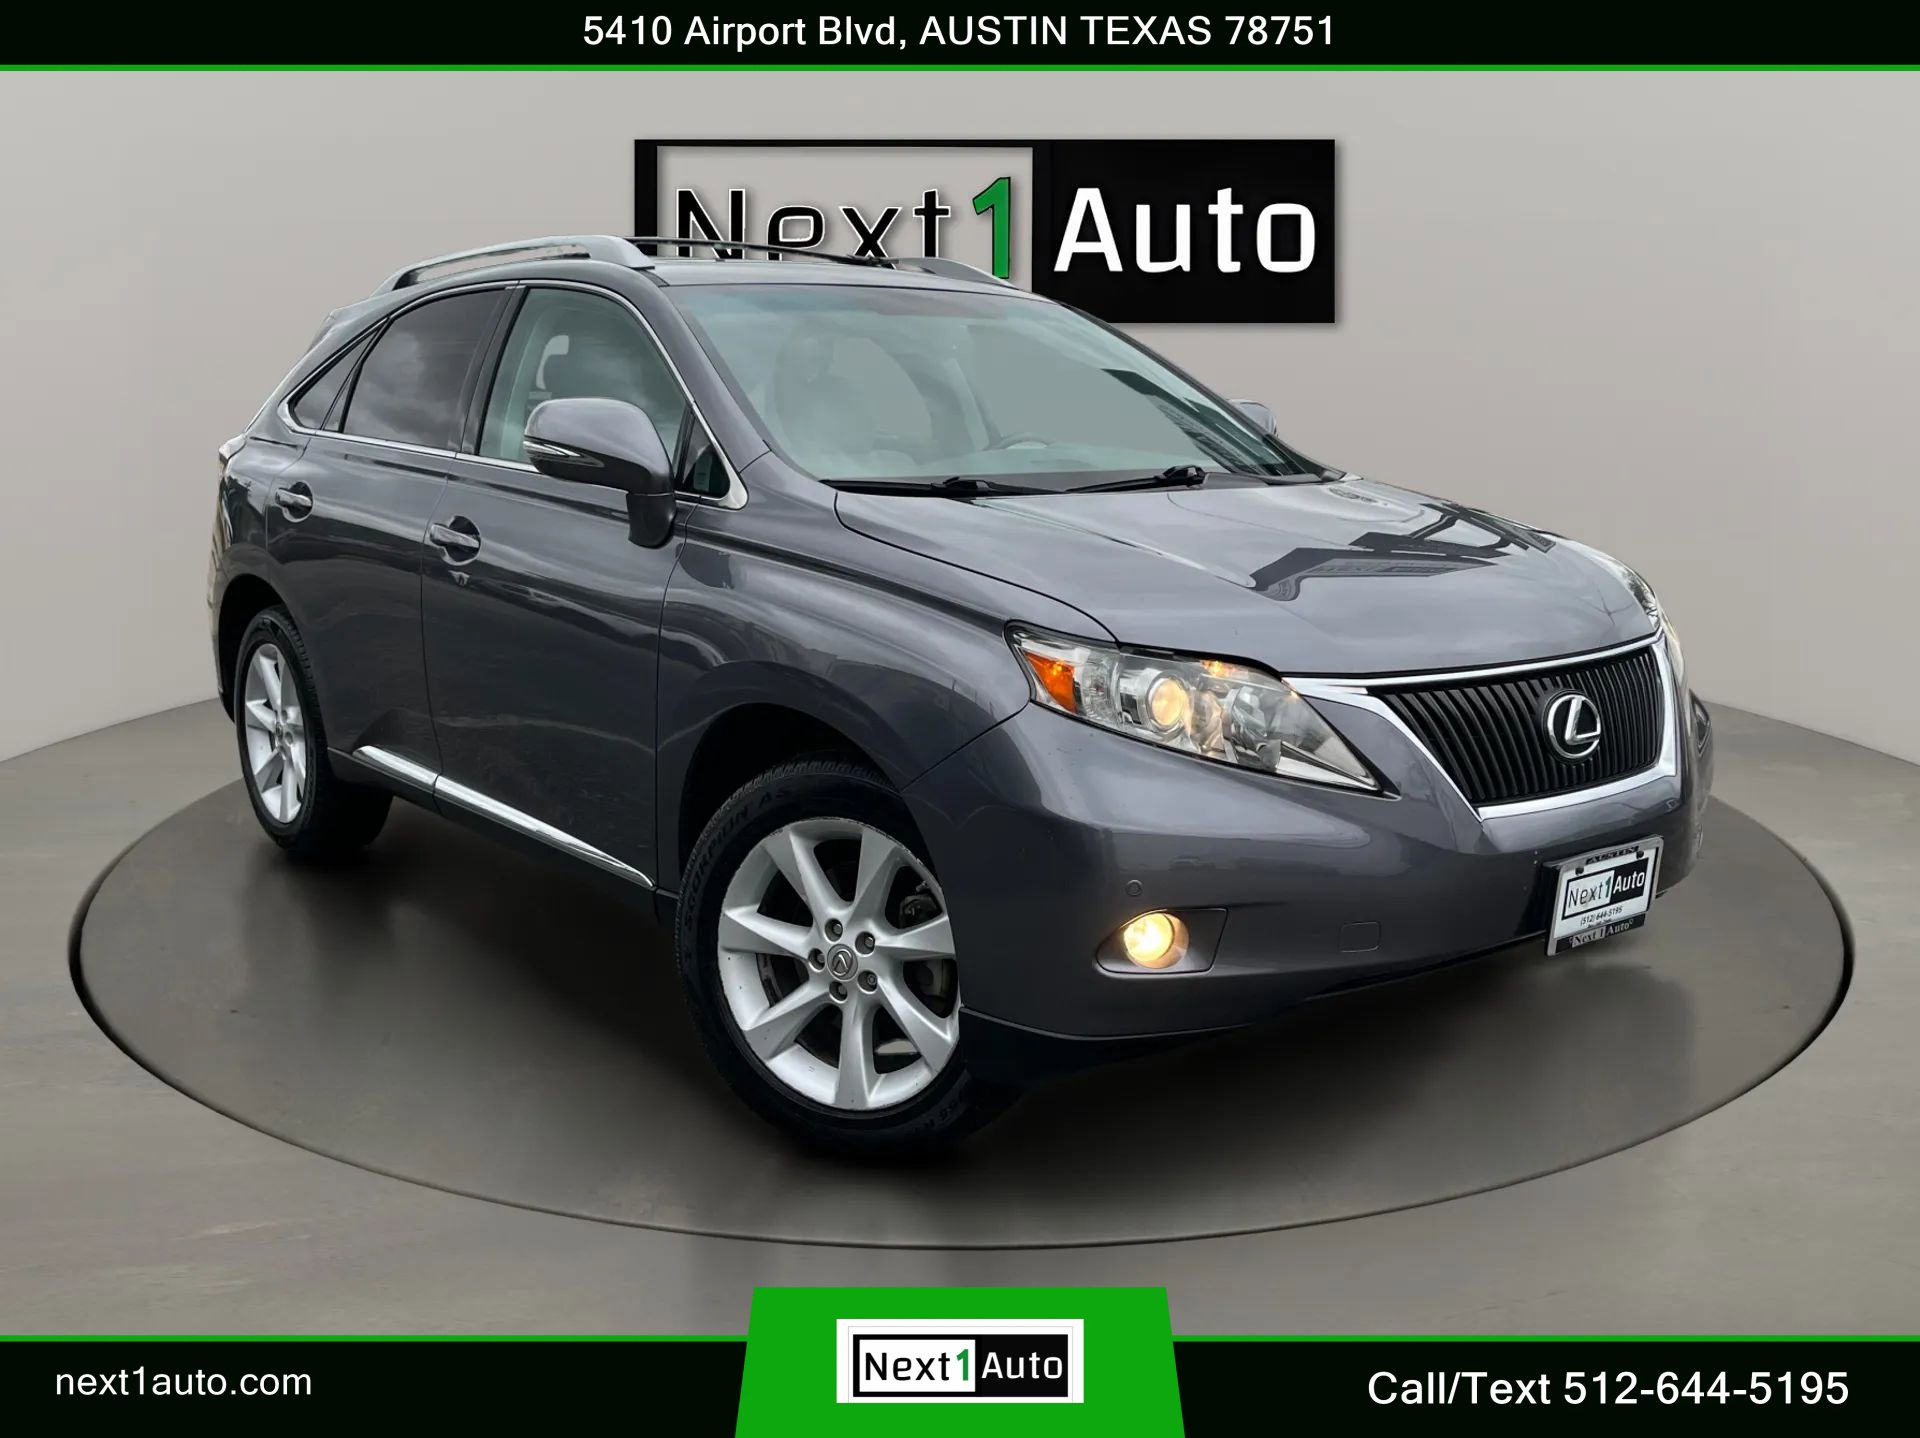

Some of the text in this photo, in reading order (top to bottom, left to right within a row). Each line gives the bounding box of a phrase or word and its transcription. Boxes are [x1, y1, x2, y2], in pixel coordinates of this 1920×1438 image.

[1053, 187, 1316, 273] Auto
[1613, 871, 1645, 894] Auto
[1606, 922, 1630, 936] Auto
